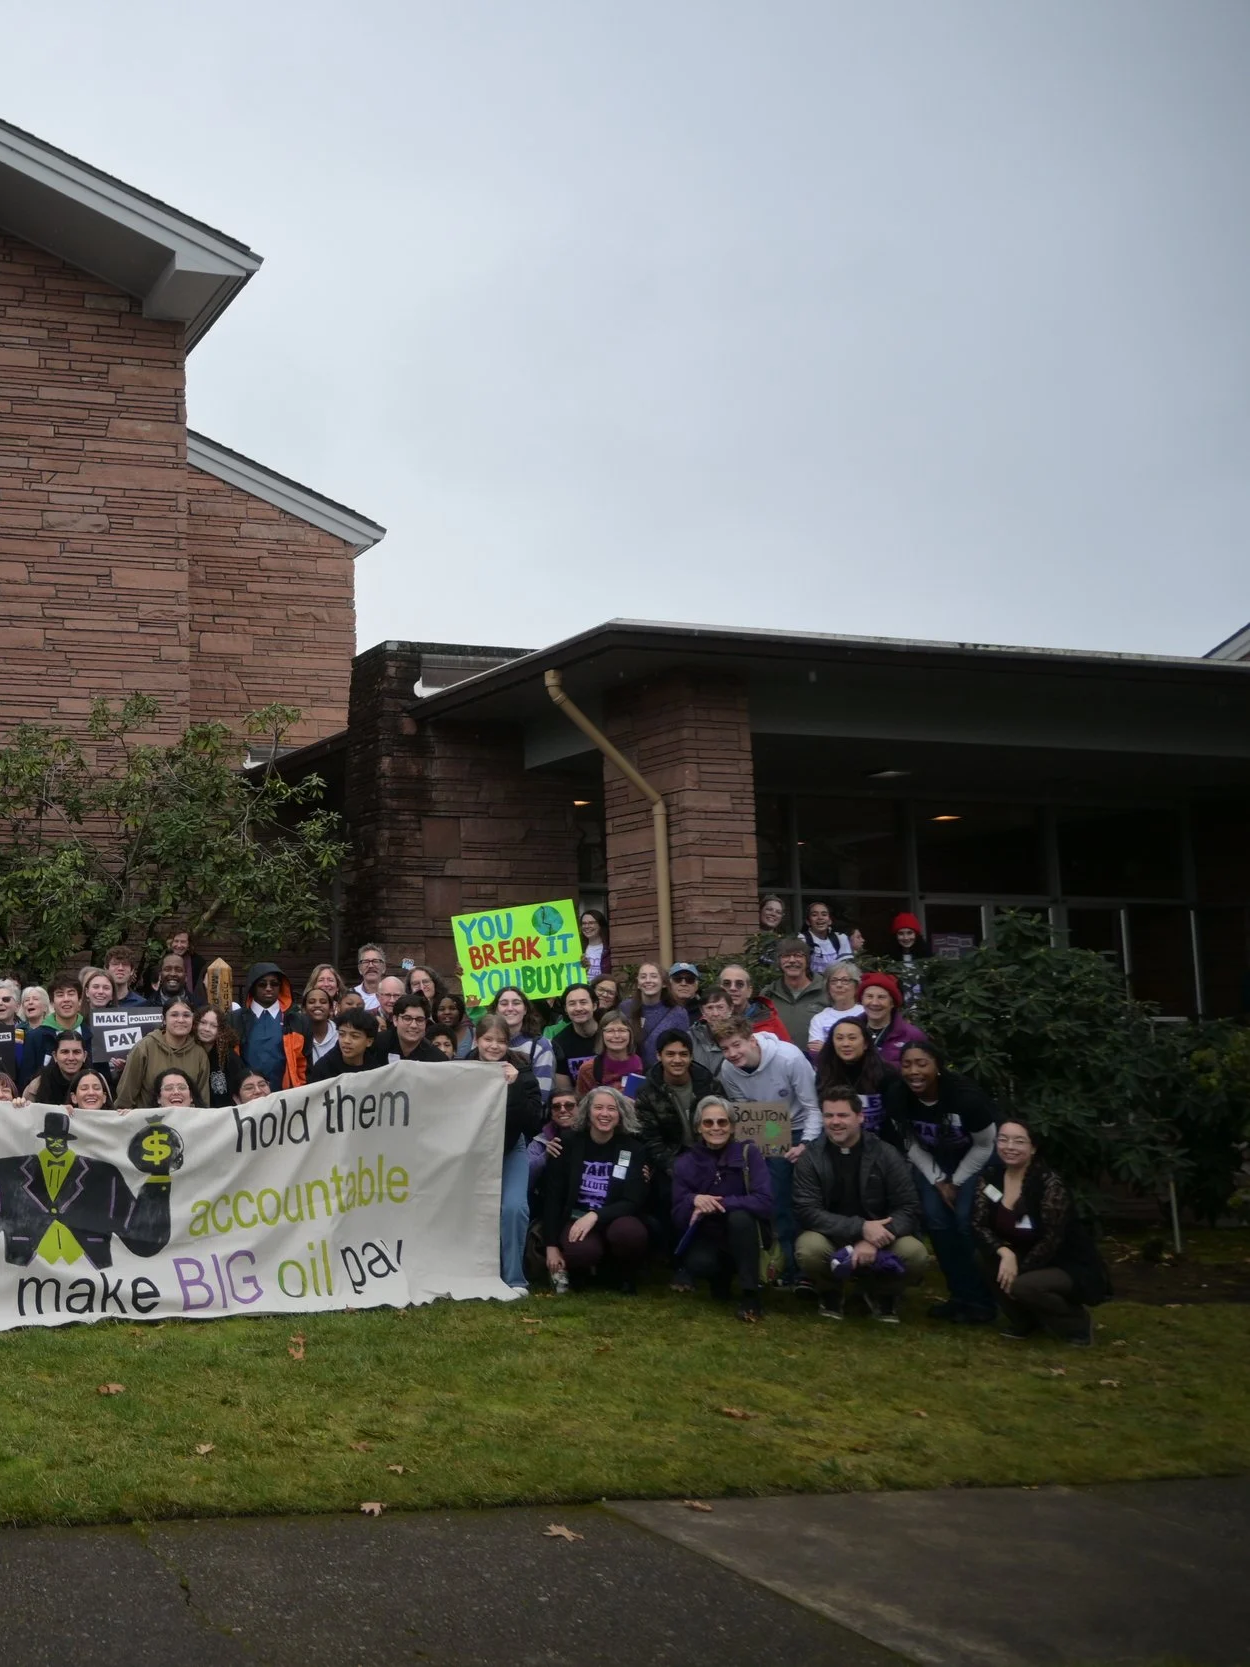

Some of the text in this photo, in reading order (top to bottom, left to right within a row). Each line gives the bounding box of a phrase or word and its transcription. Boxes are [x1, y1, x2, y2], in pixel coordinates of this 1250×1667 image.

[458, 912, 513, 946] YOU
[468, 933, 574, 970] BREAK IT
[521, 962, 565, 994] BUY
[95, 1015, 125, 1023] MAKE
[108, 1032, 137, 1047] PAY
[233, 1085, 410, 1153] hold them
[741, 1124, 762, 1136] NOT
[189, 1154, 409, 1236] accountable
[17, 1271, 161, 1317] make
[172, 1249, 264, 1311] BIG
[277, 1239, 333, 1299] oil
